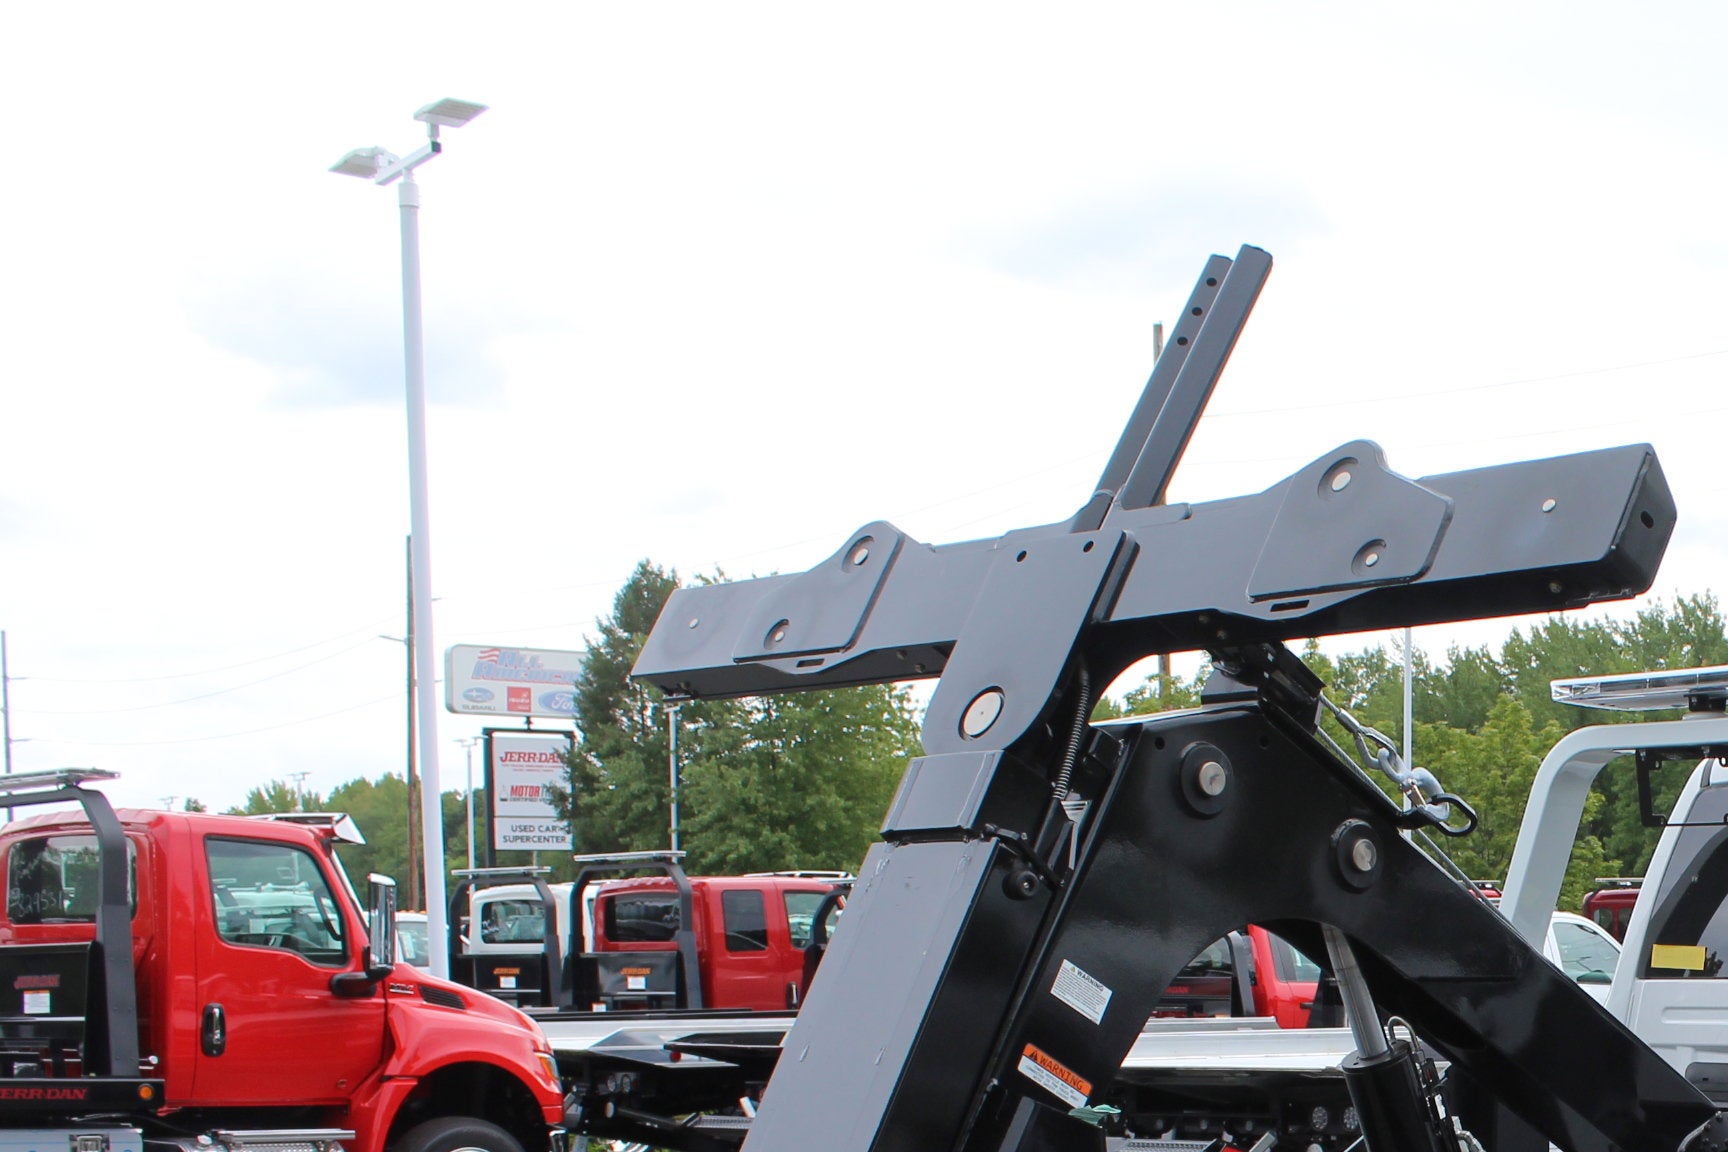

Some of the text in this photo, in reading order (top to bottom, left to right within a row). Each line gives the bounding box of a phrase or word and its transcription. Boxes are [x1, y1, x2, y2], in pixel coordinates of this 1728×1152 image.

[471, 660, 581, 683] AMERICA
[500, 751, 561, 764] JERR-DA
[511, 825, 535, 833] USED
[503, 835, 566, 843] SUPERCENTER
[1077, 969, 1104, 992] WARNING
[1040, 1056, 1084, 1091] WARNING
[0, 1088, 87, 1100] ERR-DAN
